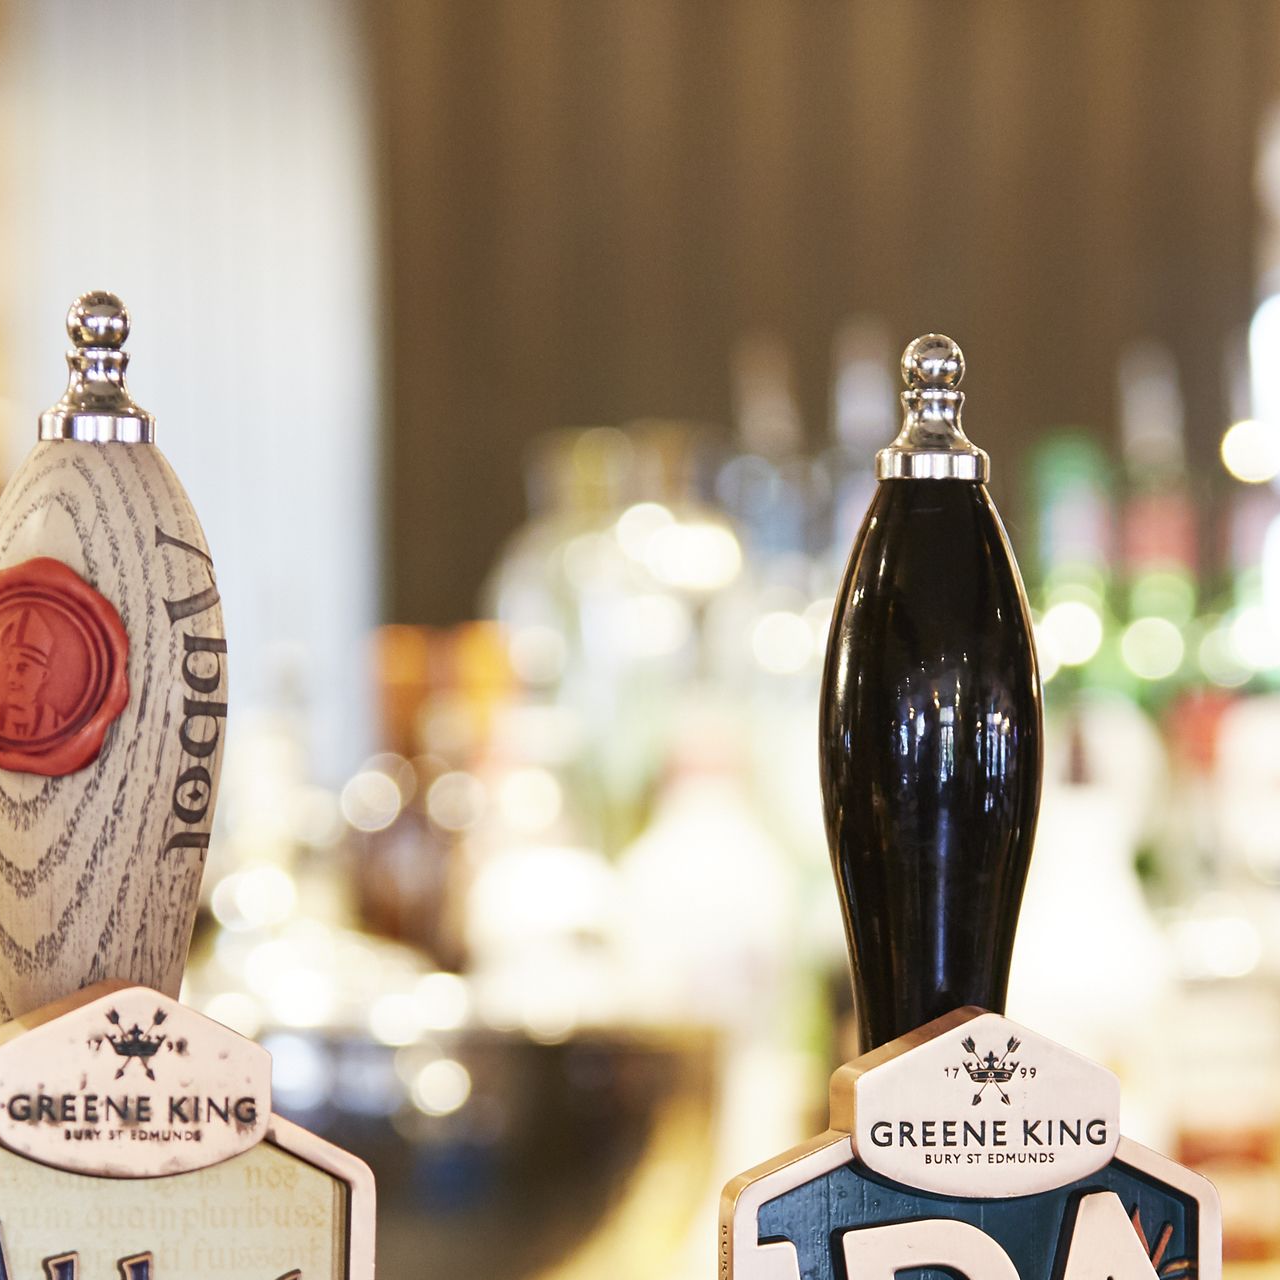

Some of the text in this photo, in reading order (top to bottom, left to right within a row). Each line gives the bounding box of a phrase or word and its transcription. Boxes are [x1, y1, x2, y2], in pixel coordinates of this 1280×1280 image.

[944, 1066, 1037, 1079] 17 99
[6, 1093, 258, 1124] GREENE KING
[63, 1128, 101, 1141] BURY
[130, 1129, 203, 1142] EDMUNDS
[869, 1118, 1108, 1147] GREENE KING
[924, 1153, 1056, 1165] BURY ST EDMUNDS
